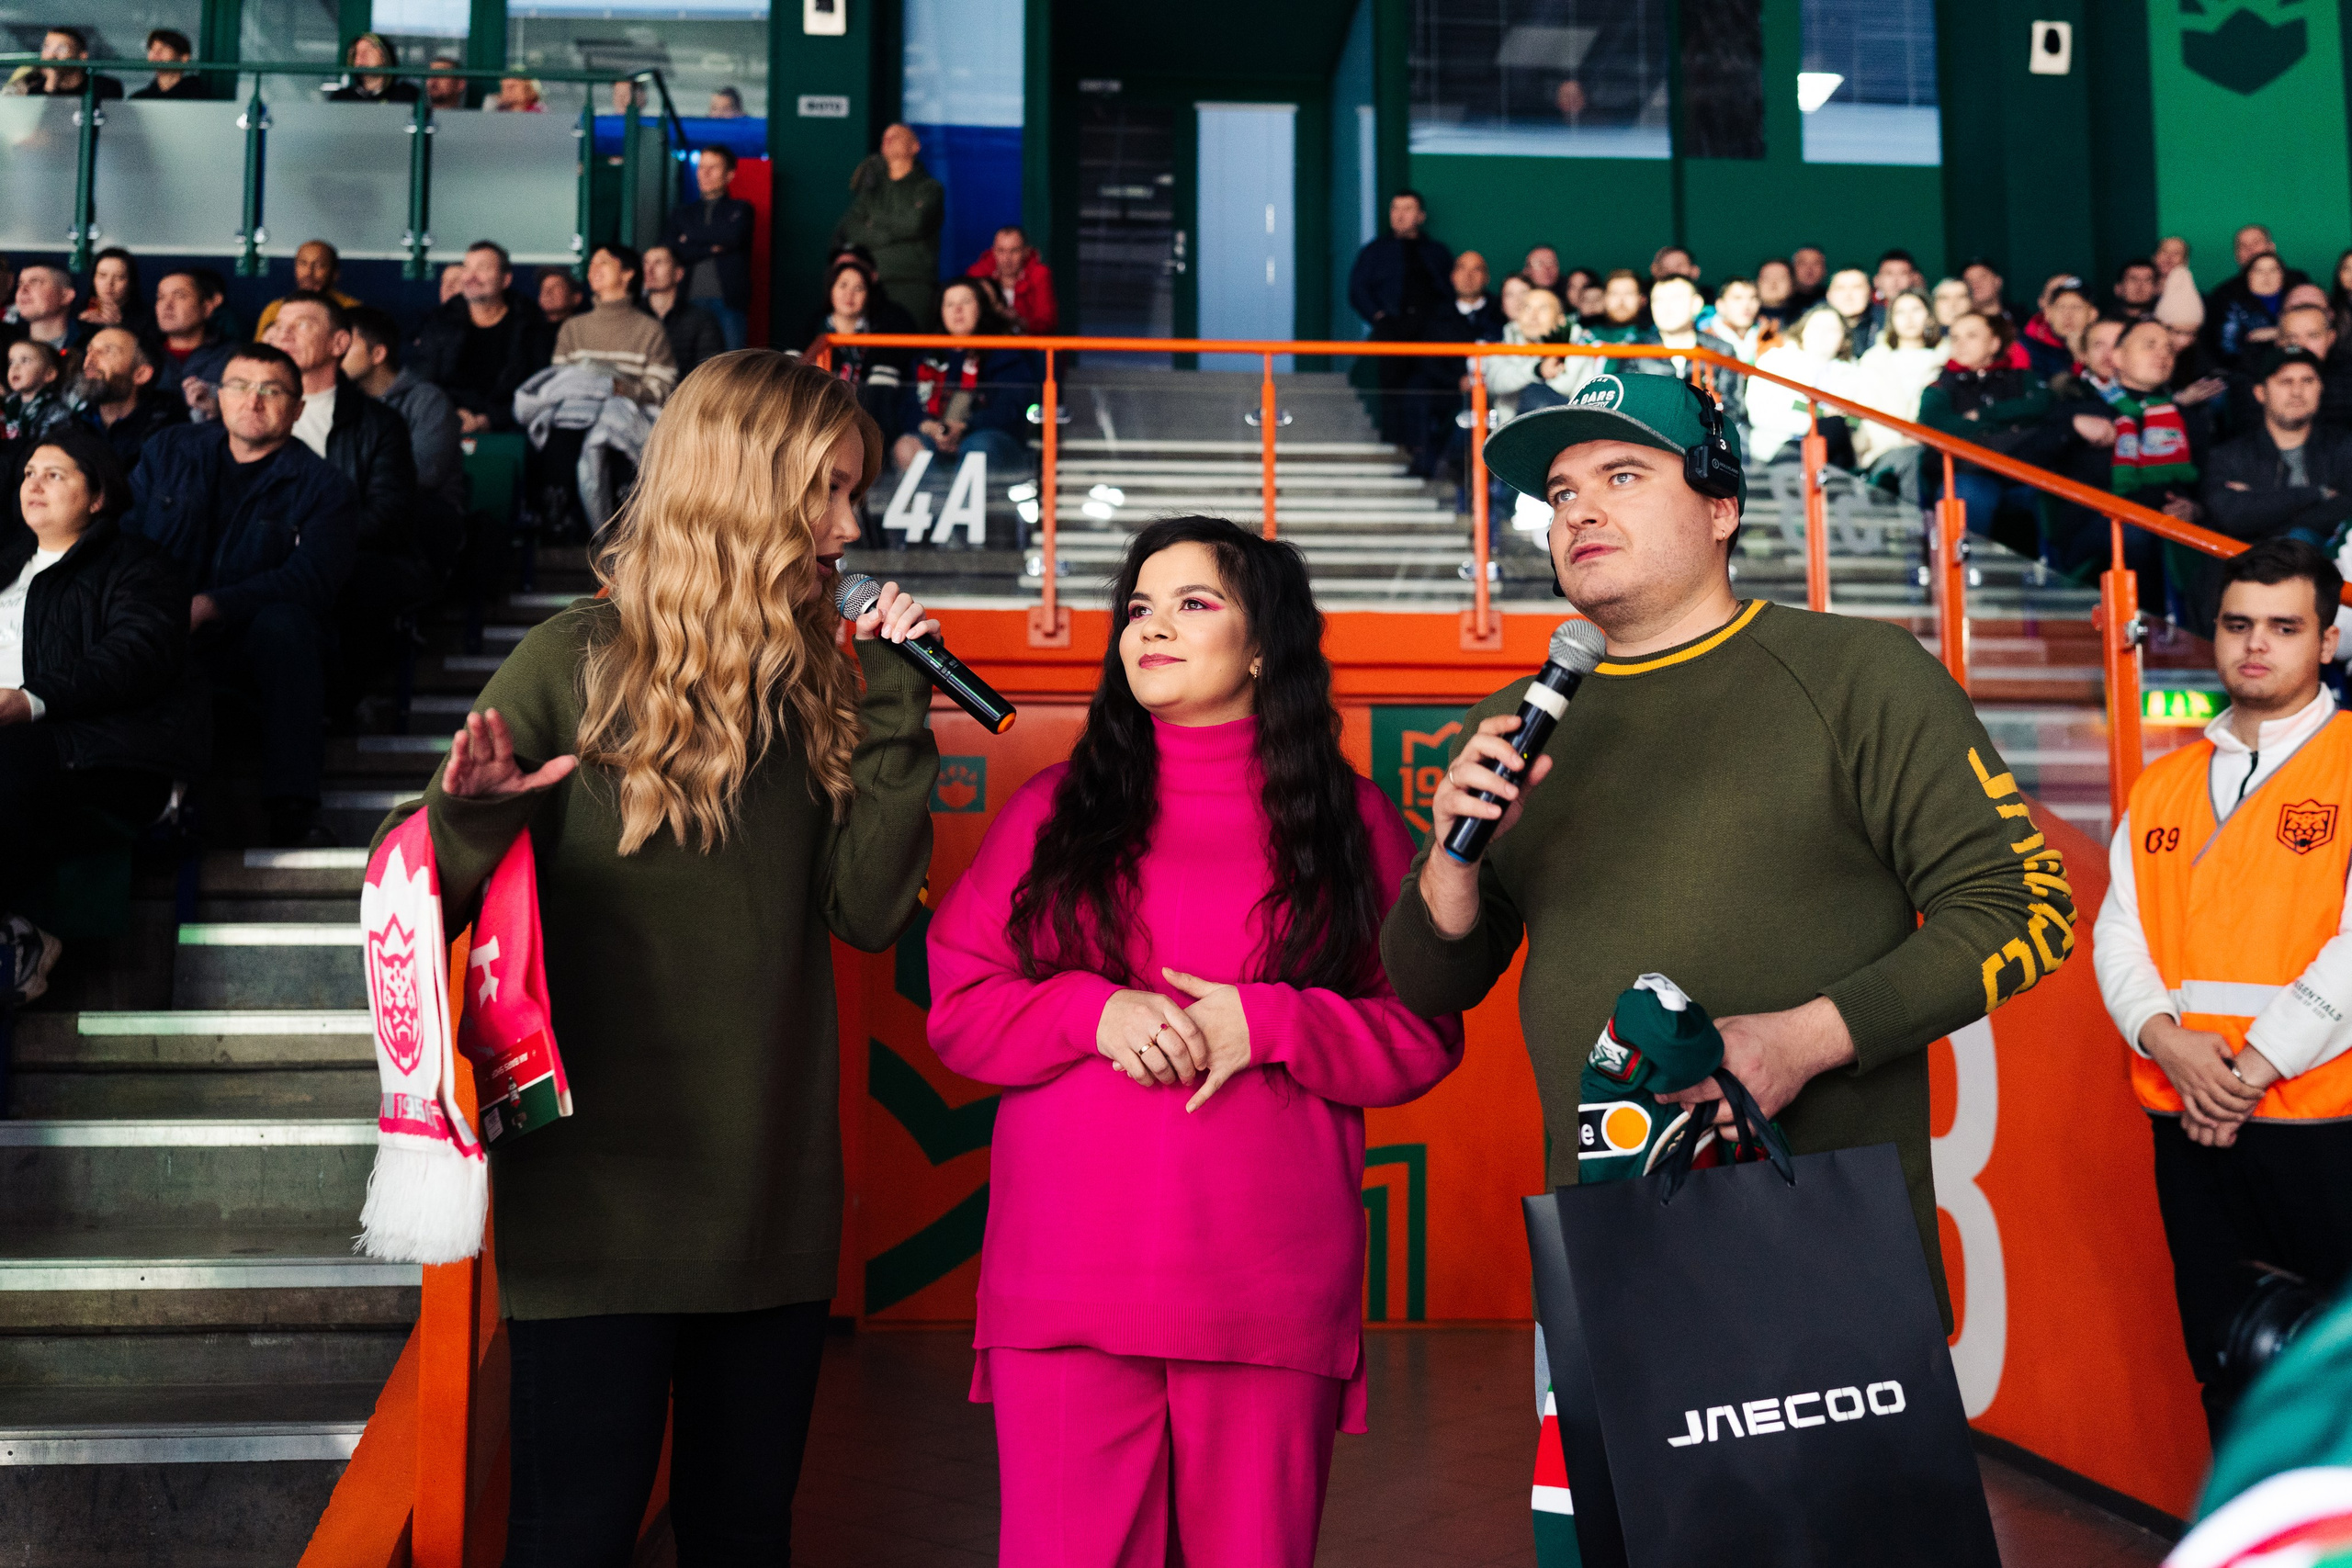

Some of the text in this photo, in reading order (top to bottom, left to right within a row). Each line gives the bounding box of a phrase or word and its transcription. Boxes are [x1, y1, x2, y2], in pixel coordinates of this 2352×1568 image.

[1580, 389, 1616, 405] BARS
[1719, 438, 1726, 450] 3
[883, 449, 987, 544] 4A
[2294, 980, 2343, 1021] SSENTIALS
[1667, 1380, 1906, 1448] JAECOO
